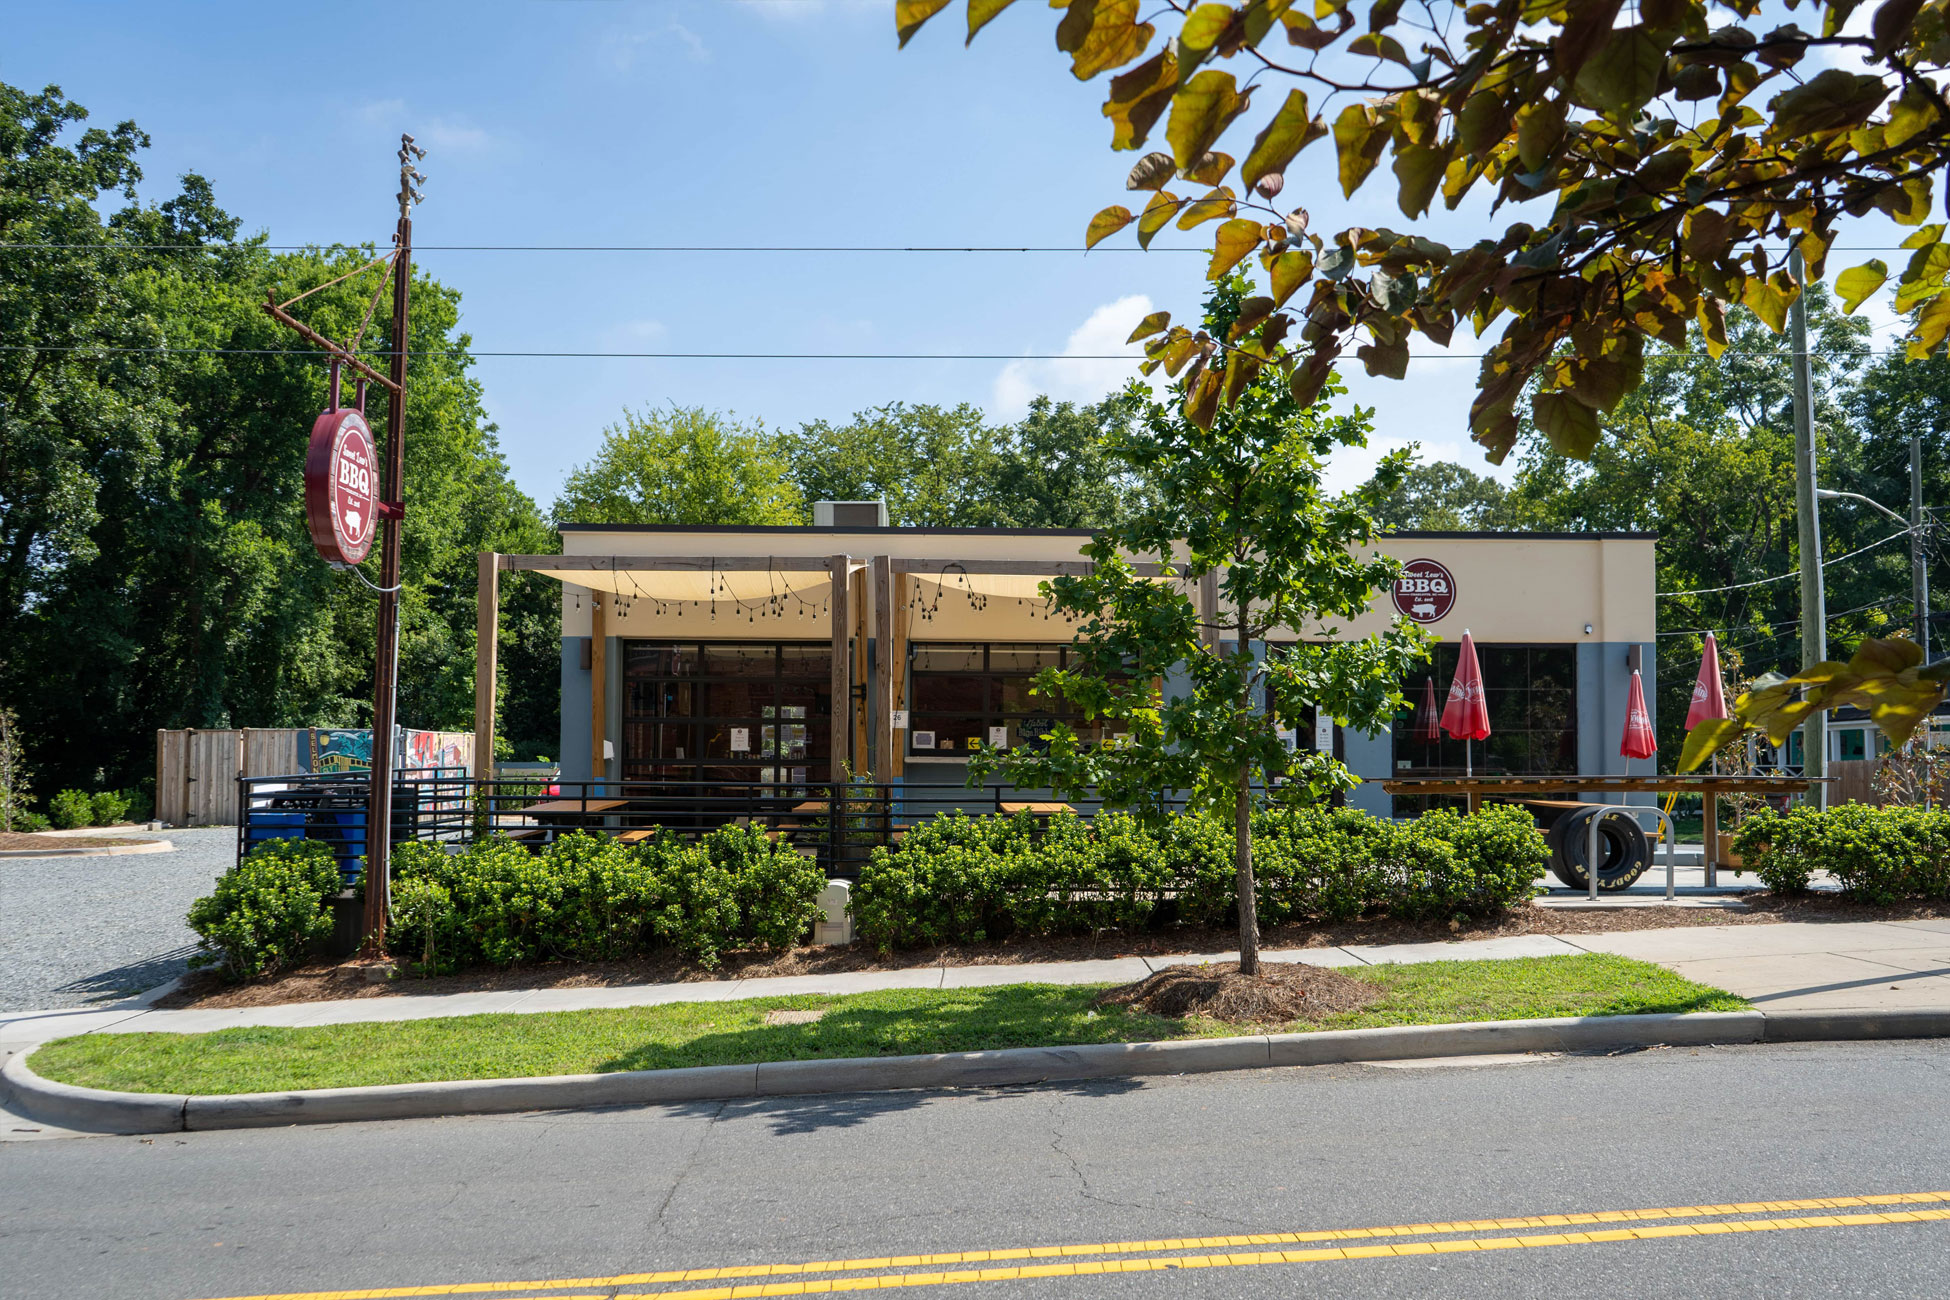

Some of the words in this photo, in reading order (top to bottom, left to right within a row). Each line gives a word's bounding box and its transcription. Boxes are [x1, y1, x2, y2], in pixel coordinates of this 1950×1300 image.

[339, 457, 370, 496] BBQ
[1400, 578, 1448, 593] BBQ
[310, 733, 319, 776] BELMON
